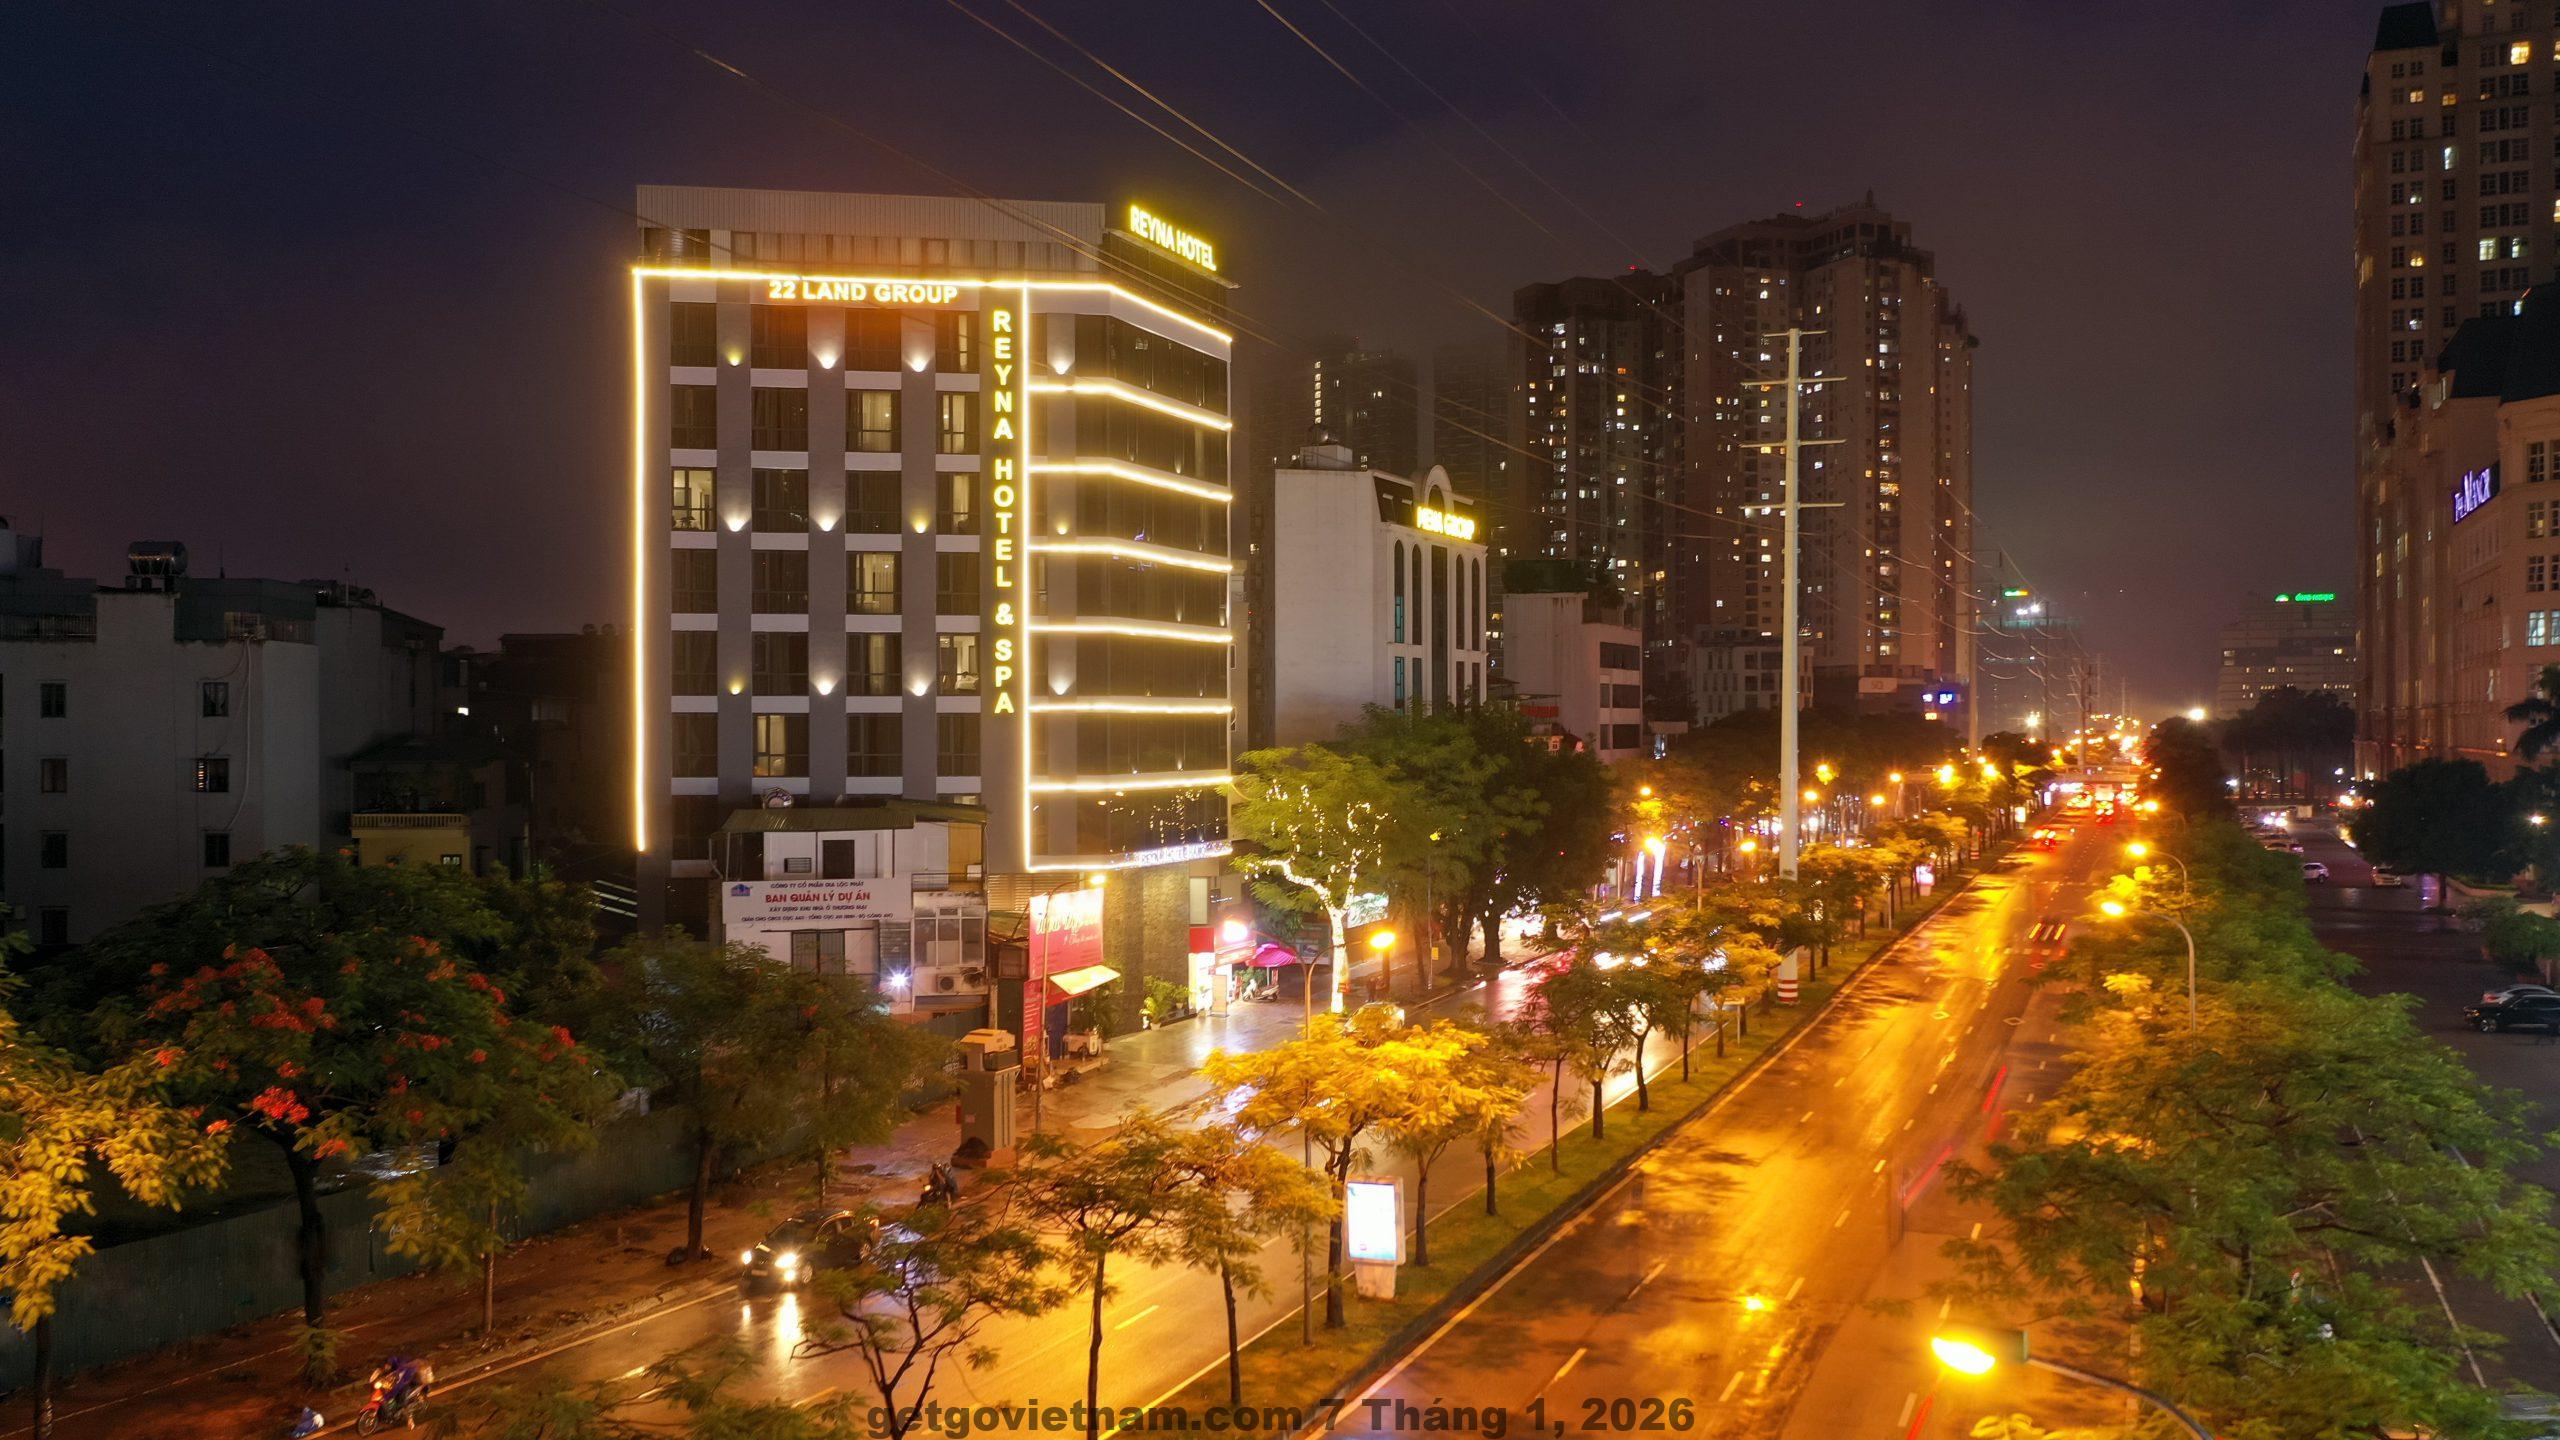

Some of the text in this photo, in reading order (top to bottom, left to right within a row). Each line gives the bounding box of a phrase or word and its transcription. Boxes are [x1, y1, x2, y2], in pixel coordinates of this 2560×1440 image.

[1130, 204, 1217, 272] REYNA HOTEL
[769, 280, 958, 304] 22 LAND GROUP
[992, 310, 1015, 714] REYNA HOTEL & SPA
[765, 889, 871, 904] BAN QUẢN LÝ DỰ ÁN
